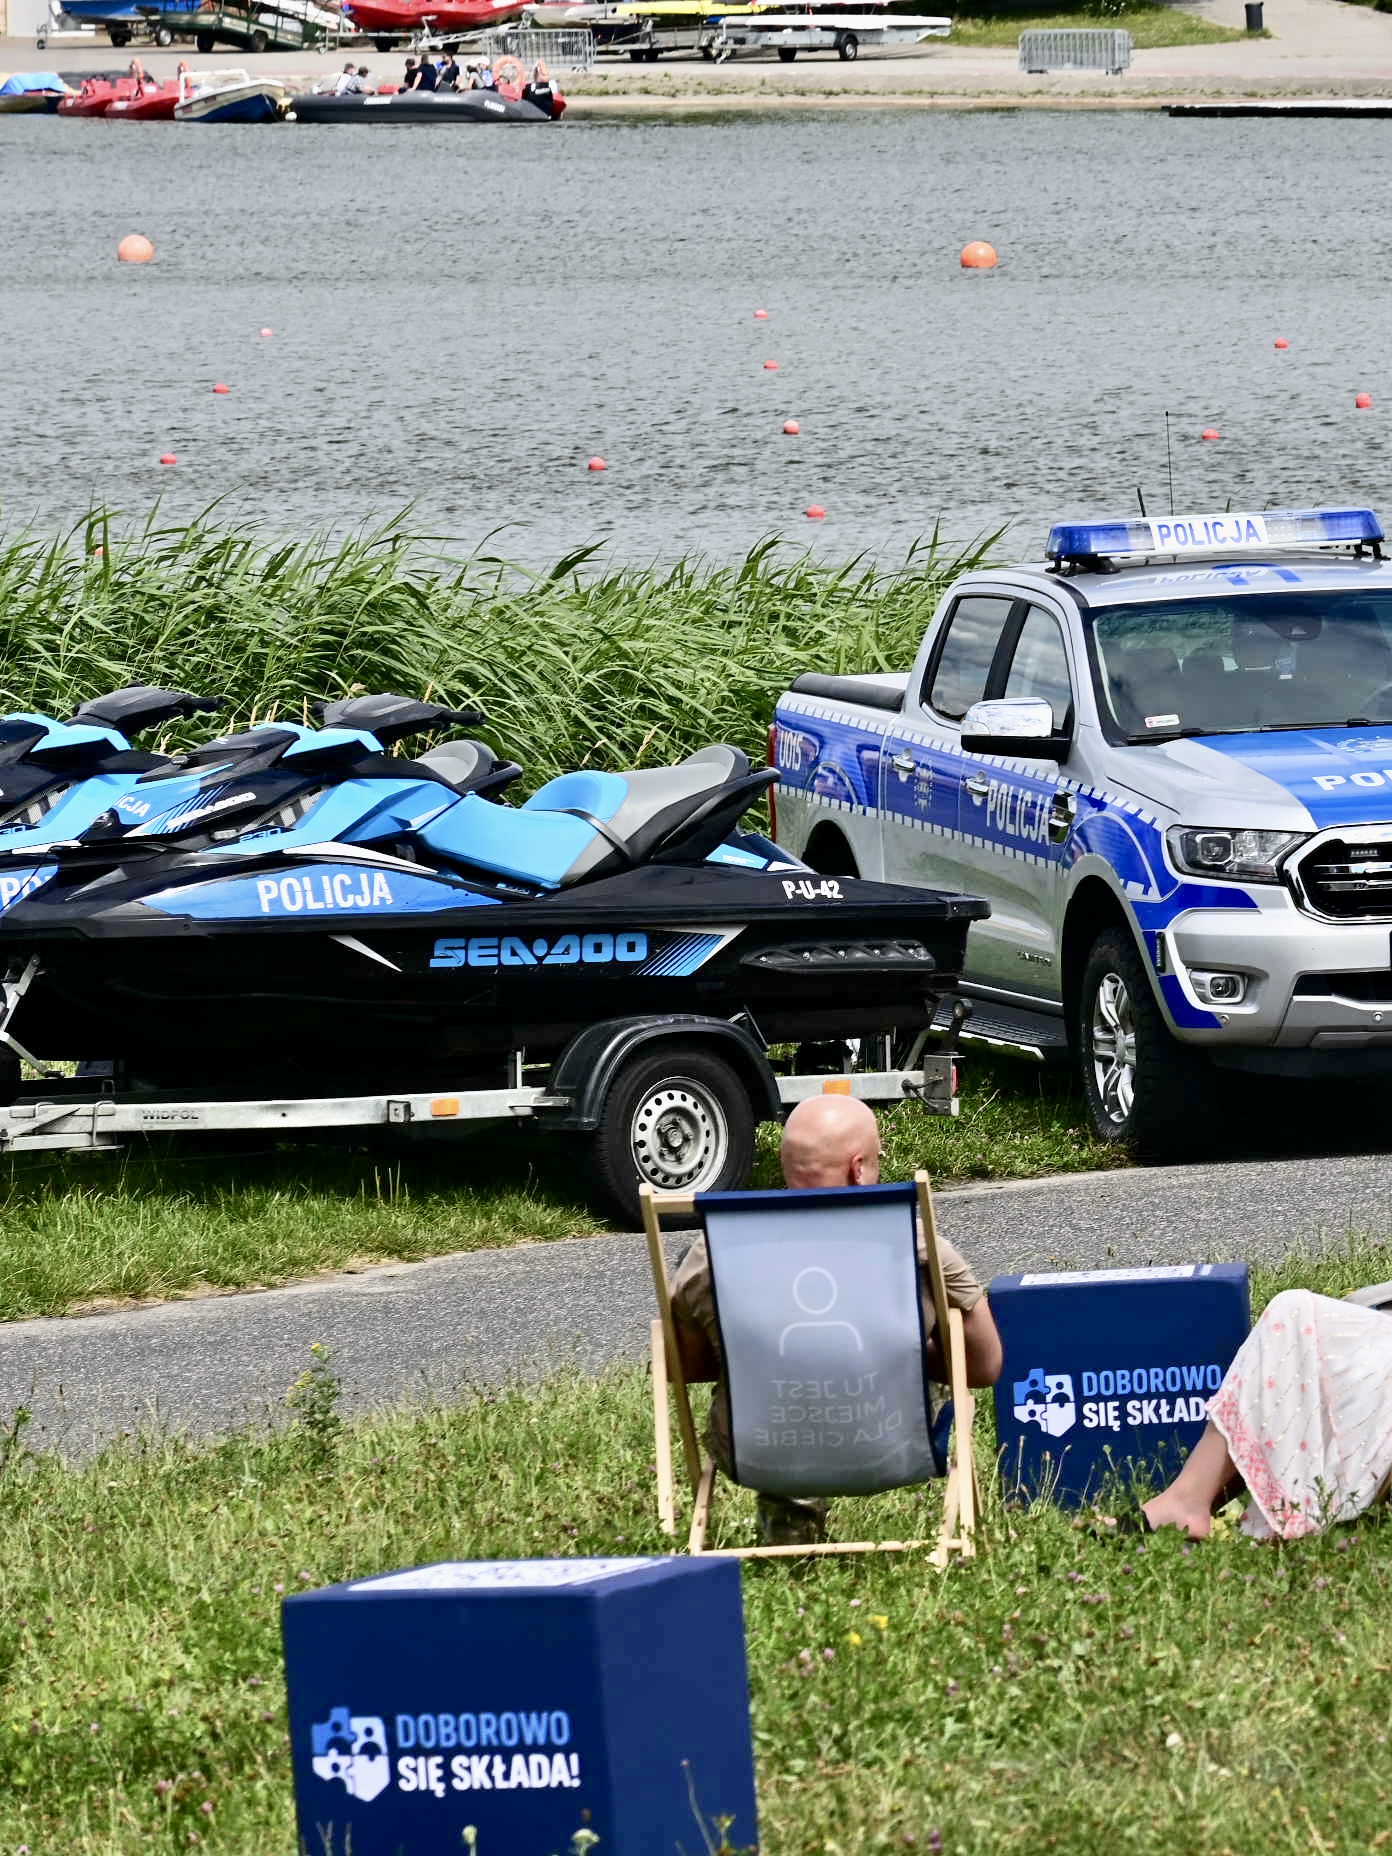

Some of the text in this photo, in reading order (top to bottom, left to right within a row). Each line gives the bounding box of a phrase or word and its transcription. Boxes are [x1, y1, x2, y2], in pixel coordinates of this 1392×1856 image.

[1157, 519, 1262, 546] POLICJA
[986, 779, 1051, 847] POLICJA
[256, 873, 394, 913] POLICJA
[782, 880, 844, 900] P-U-42
[1082, 1365, 1222, 1396] DOBOROWO
[1083, 1397, 1209, 1431] SIĘ SKŁAD
[396, 1710, 570, 1749] DOBOROWO
[397, 1753, 581, 1798] SIĘ SKŁADA!
